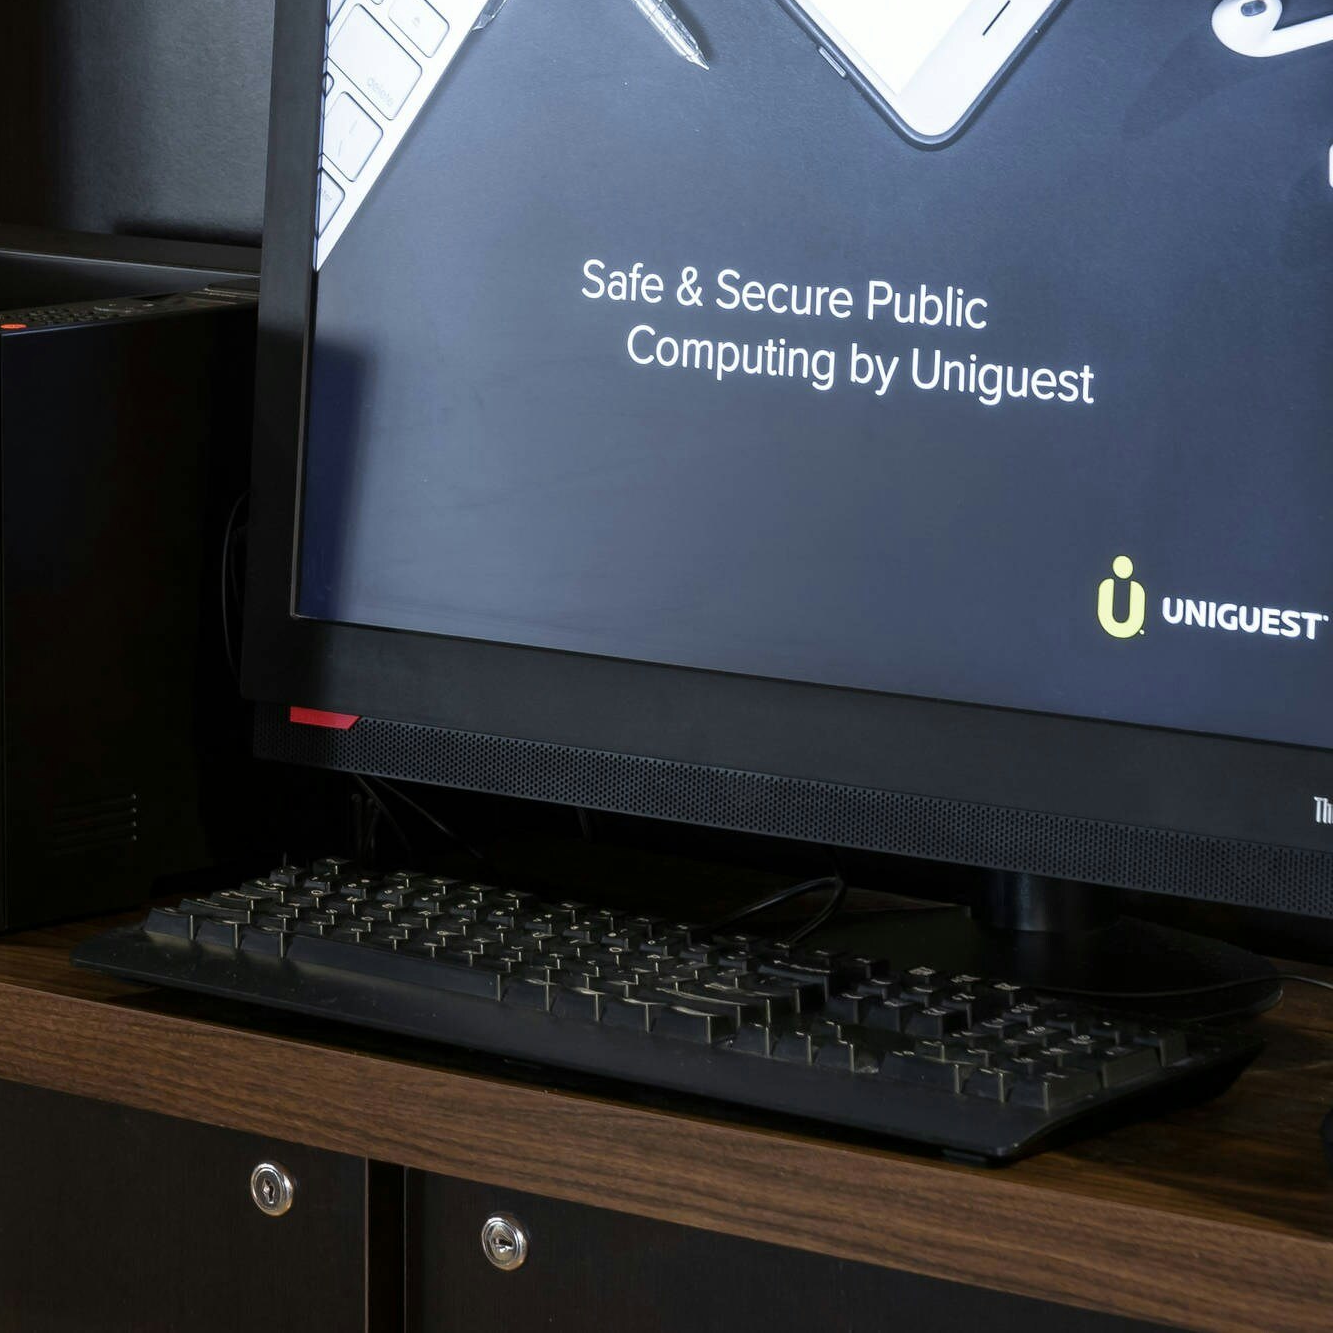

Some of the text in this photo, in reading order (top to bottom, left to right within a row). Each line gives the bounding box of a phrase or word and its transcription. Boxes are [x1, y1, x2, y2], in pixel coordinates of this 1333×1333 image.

[581, 258, 988, 330] Safe & Secure Public
[627, 324, 1095, 406] Computing by Uniguest
[1162, 596, 1323, 640] UNIGUEST
